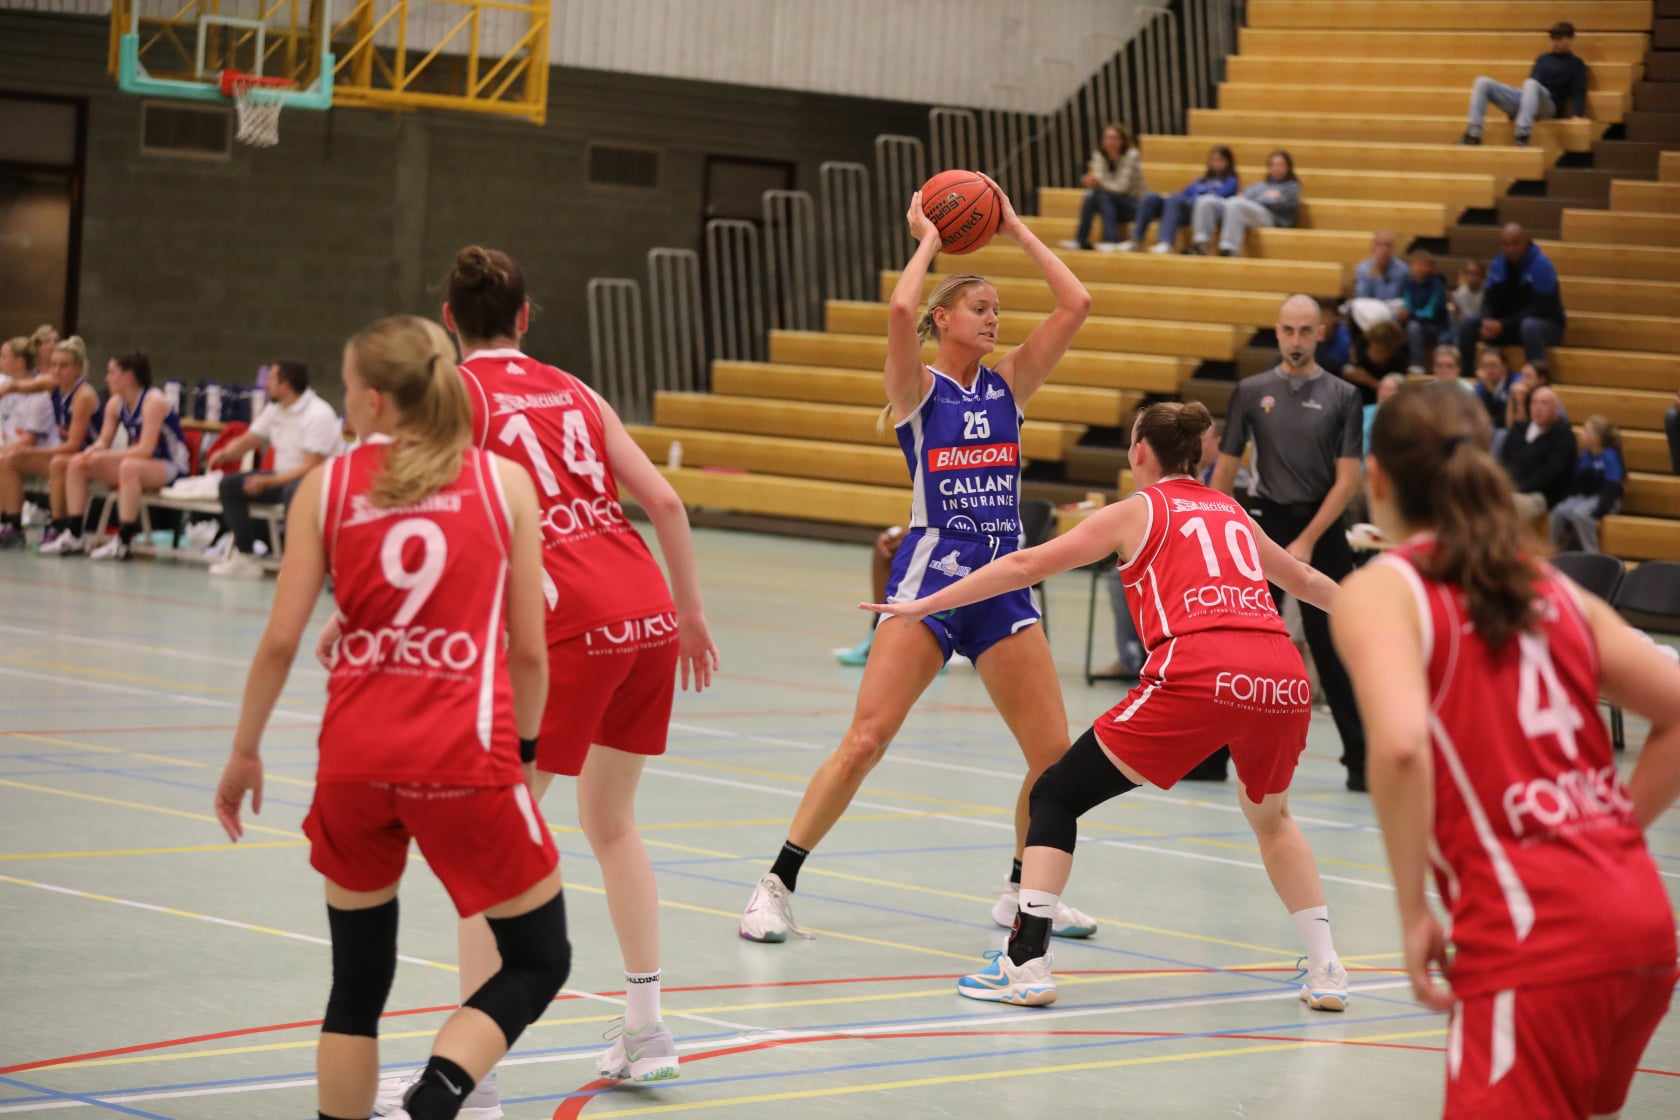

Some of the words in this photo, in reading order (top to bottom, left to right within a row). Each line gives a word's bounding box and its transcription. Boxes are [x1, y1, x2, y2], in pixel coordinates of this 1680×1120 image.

[963, 409, 991, 440] 25
[498, 410, 605, 497] 14
[939, 475, 1014, 496] CALLANT
[943, 495, 1014, 511] INSURANCE
[381, 517, 448, 627] 9
[1179, 516, 1264, 582] 10
[1215, 672, 1310, 706] FOMECO
[1517, 631, 1584, 760] 4
